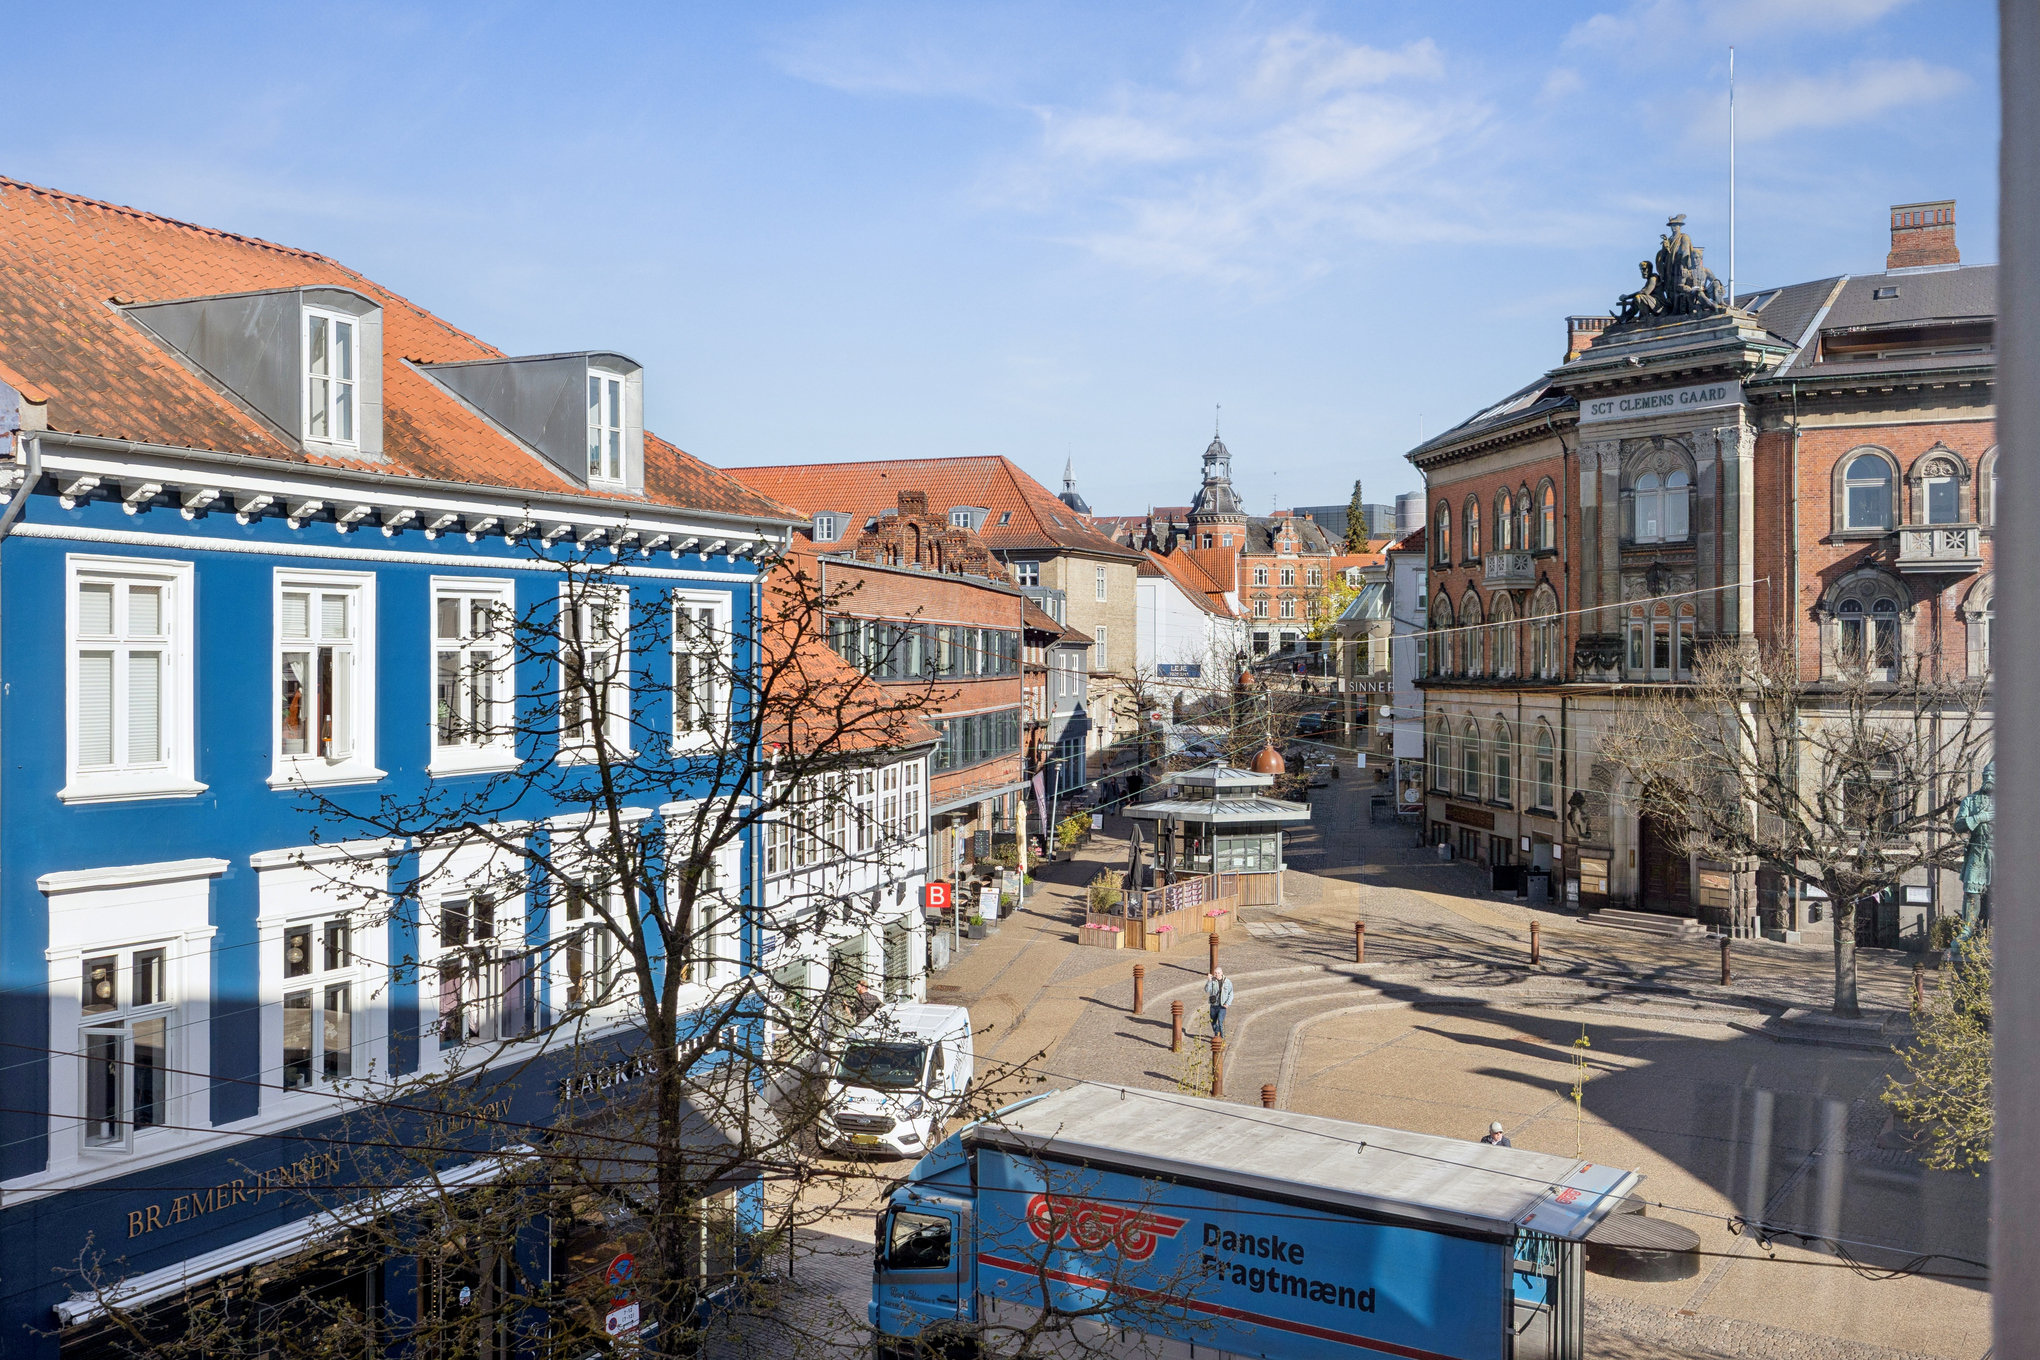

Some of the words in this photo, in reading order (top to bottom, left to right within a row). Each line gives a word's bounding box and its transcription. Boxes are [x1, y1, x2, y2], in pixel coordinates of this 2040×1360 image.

[1591, 402, 1615, 416] SCT
[1619, 393, 1674, 412] CLEMENS
[1680, 387, 1726, 404] GAARD
[930, 886, 945, 905] B
[127, 1149, 342, 1239] BRÆMER-JENSEN
[1203, 1222, 1305, 1265] Danske
[1201, 1254, 1376, 1314] Fragtmænd
